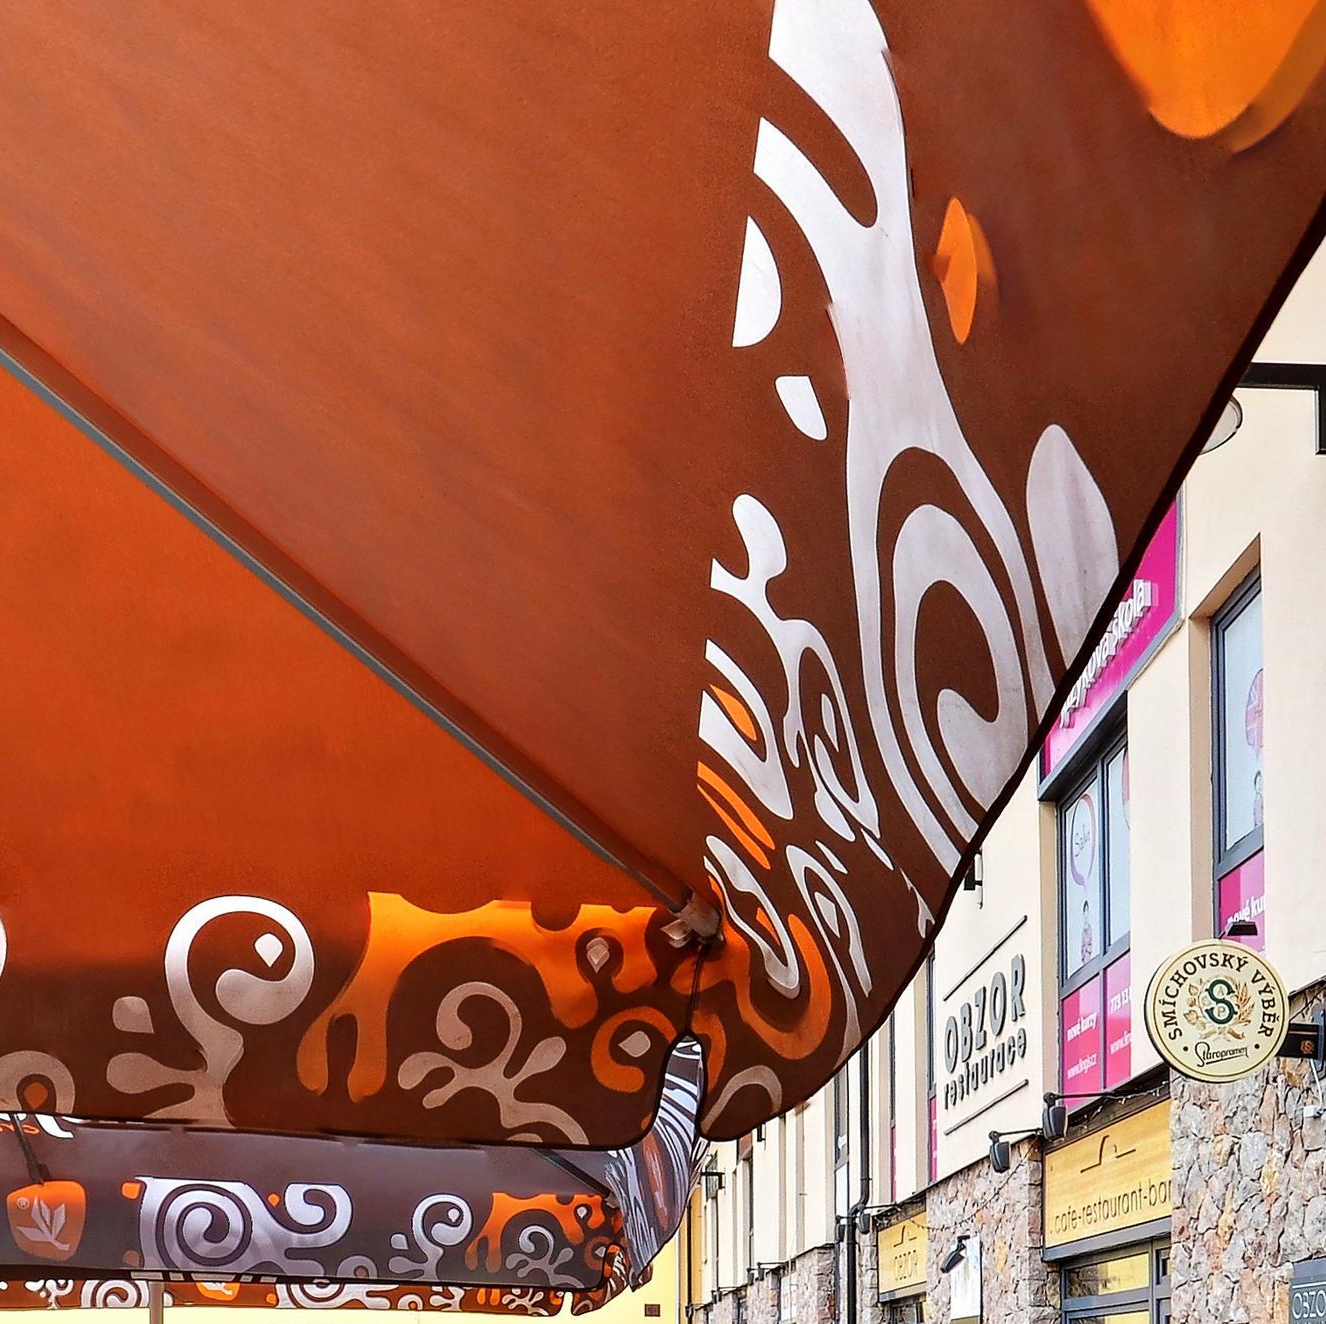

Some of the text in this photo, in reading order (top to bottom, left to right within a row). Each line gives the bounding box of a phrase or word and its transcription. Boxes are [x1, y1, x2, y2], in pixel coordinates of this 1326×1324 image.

[944, 953, 1027, 1074] OBZOR
[1158, 952, 1282, 1041] SMÍCHOVSKÝ VÝBĚR
[944, 1027, 1028, 1110] restaurace
